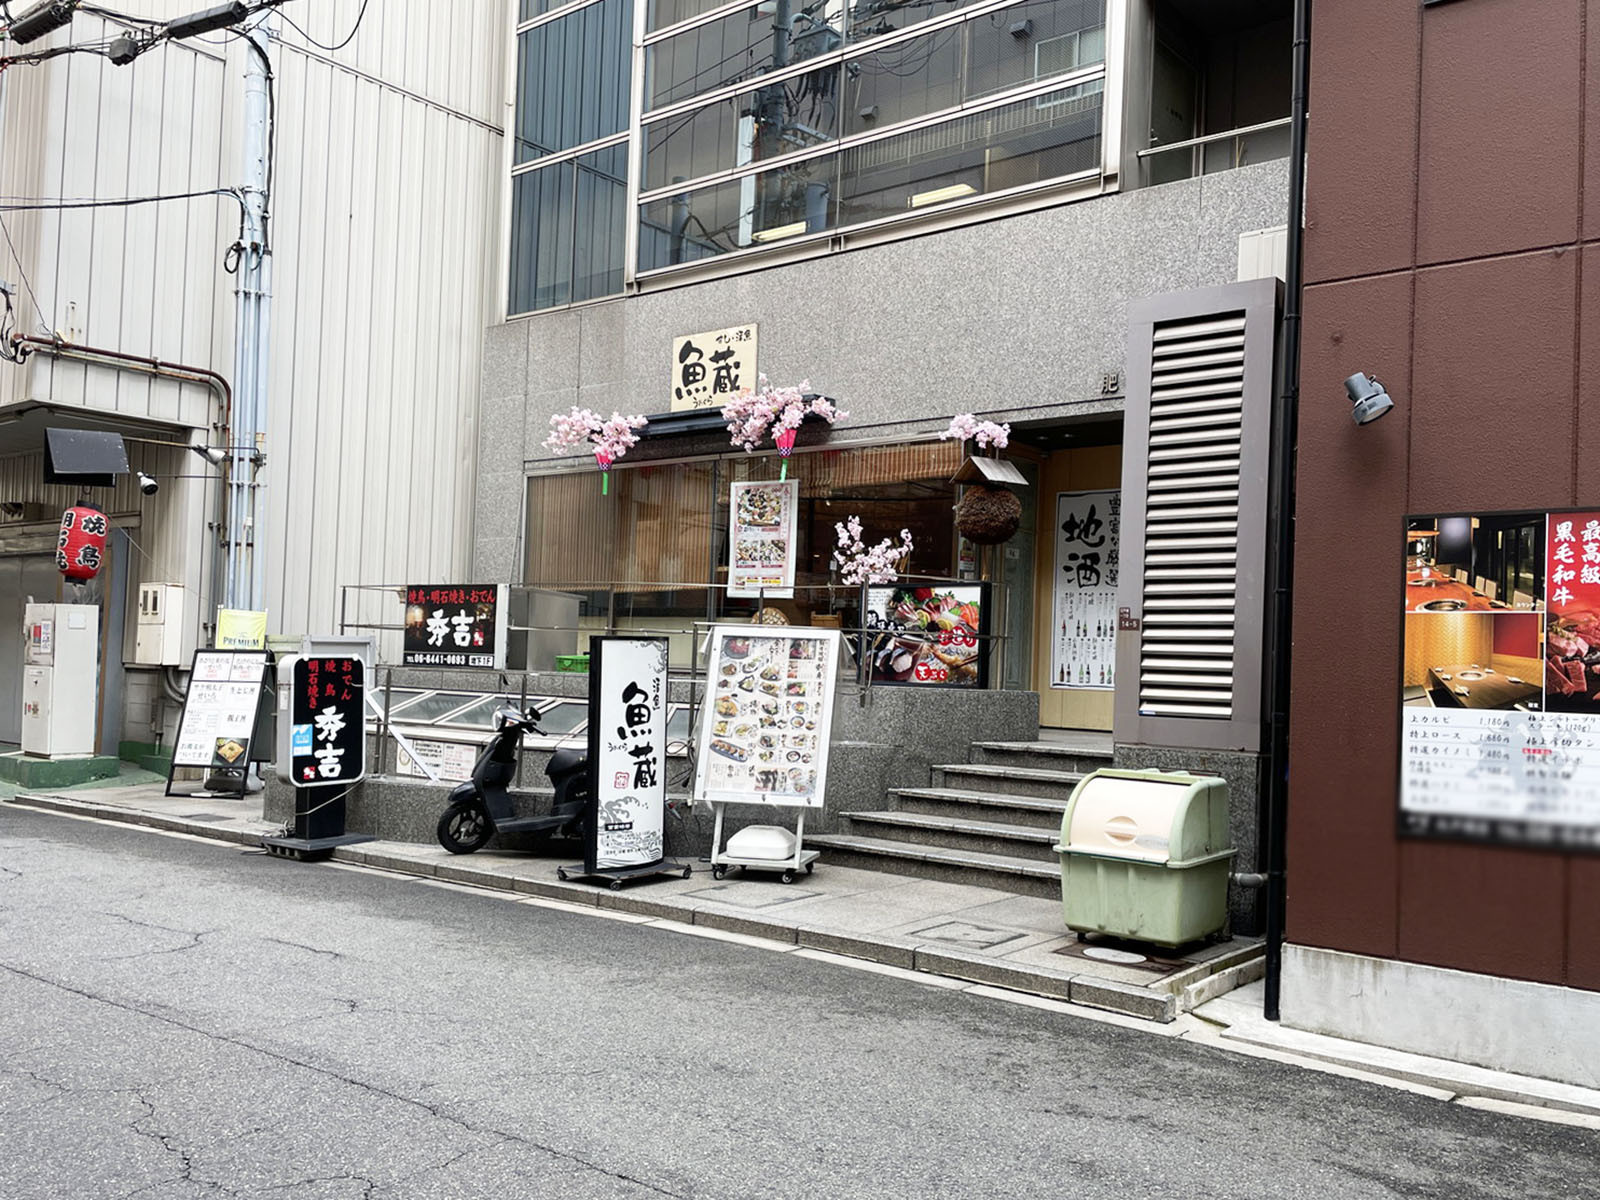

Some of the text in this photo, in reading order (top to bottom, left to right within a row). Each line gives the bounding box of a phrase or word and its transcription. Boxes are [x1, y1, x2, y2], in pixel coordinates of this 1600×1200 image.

[675, 340, 741, 400] 魚蔵
[75, 514, 106, 570] 焼鳥
[1062, 504, 1105, 588] 地酒
[1552, 520, 1577, 607] 黒毛和牛
[1580, 519, 1600, 585] 最高級
[223, 637, 259, 647] PREMIUM
[426, 608, 475, 648] 秀吉
[308, 660, 319, 709] 明石焼き
[325, 660, 336, 697] 焼鳥
[341, 660, 352, 700] おでん
[314, 705, 346, 778] 秀吉
[616, 681, 657, 790] 魚蔵
[1410, 730, 1460, 739] 特上ロース
[1411, 715, 1450, 723] 上カルビ
